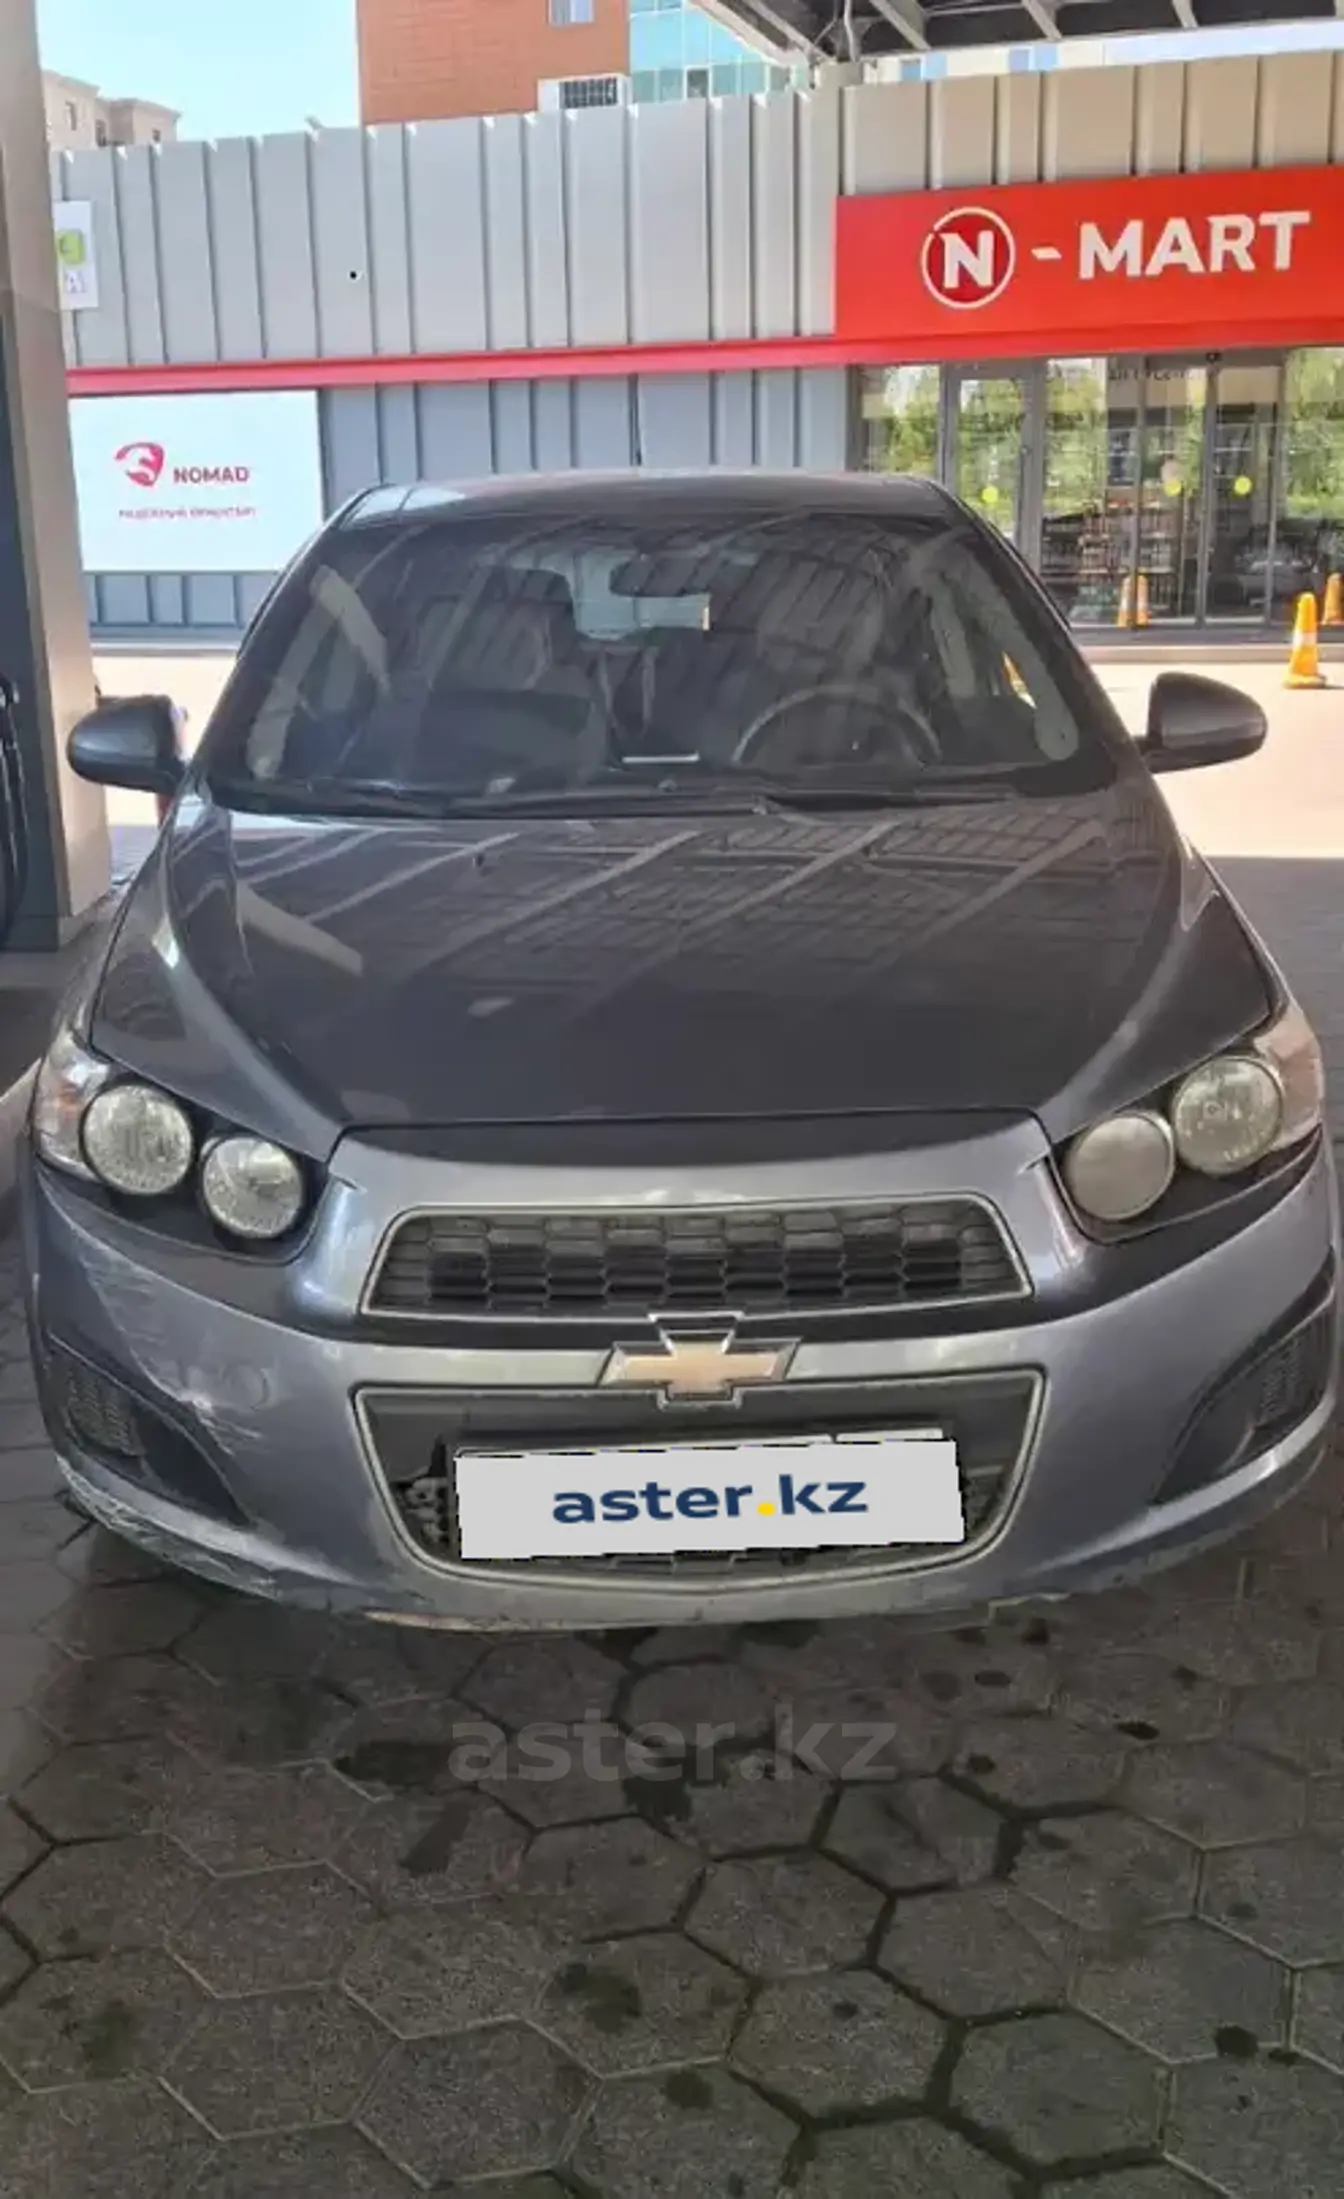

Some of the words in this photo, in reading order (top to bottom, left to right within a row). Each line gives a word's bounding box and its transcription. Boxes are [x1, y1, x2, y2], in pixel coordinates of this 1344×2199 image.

[940, 229, 993, 288] N
[1080, 212, 1310, 280] MART
[173, 466, 250, 484] NOMAD
